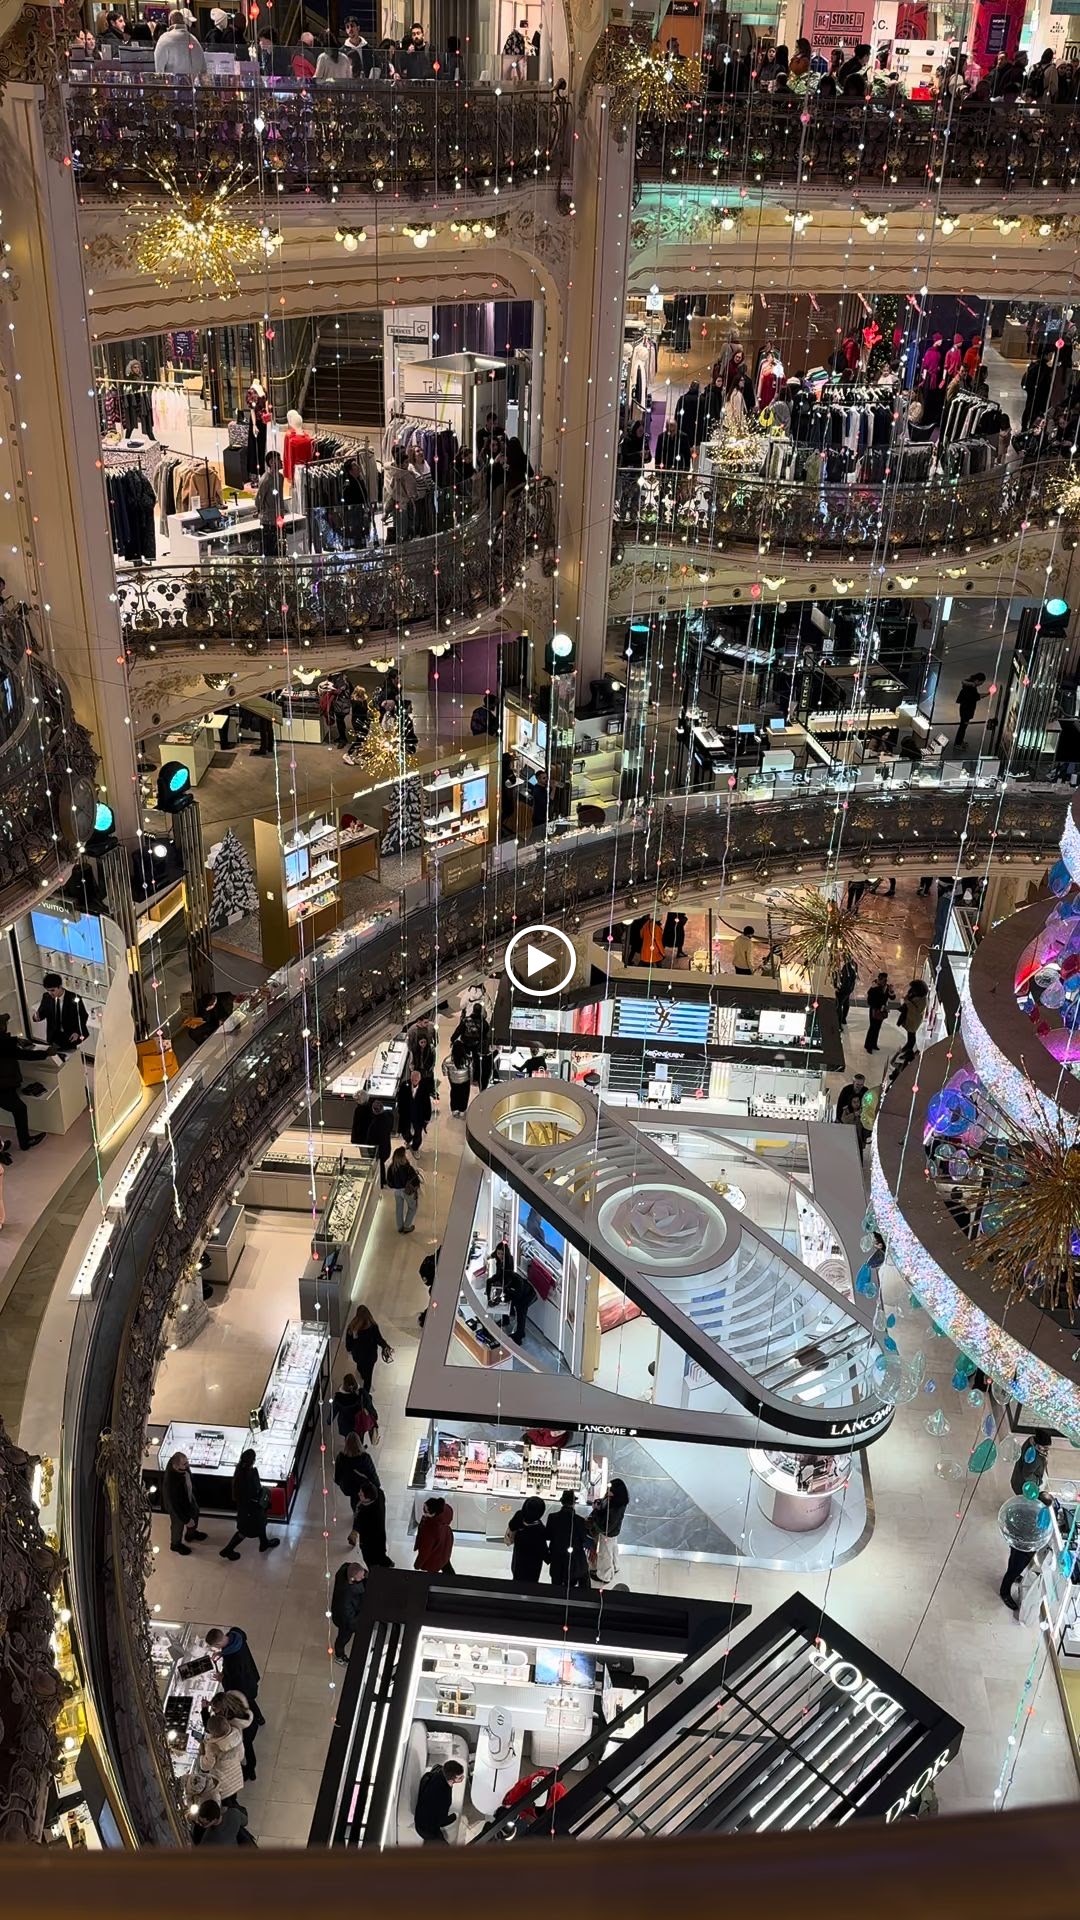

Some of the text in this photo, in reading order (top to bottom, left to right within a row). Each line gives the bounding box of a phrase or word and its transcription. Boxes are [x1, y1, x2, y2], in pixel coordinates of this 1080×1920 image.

[832, 14, 854, 25] STORE
[843, 36, 860, 46] MAIN
[1065, 45, 1080, 60] TO
[808, 1637, 906, 1728] DIOR
[885, 1749, 950, 1824] DIOR
